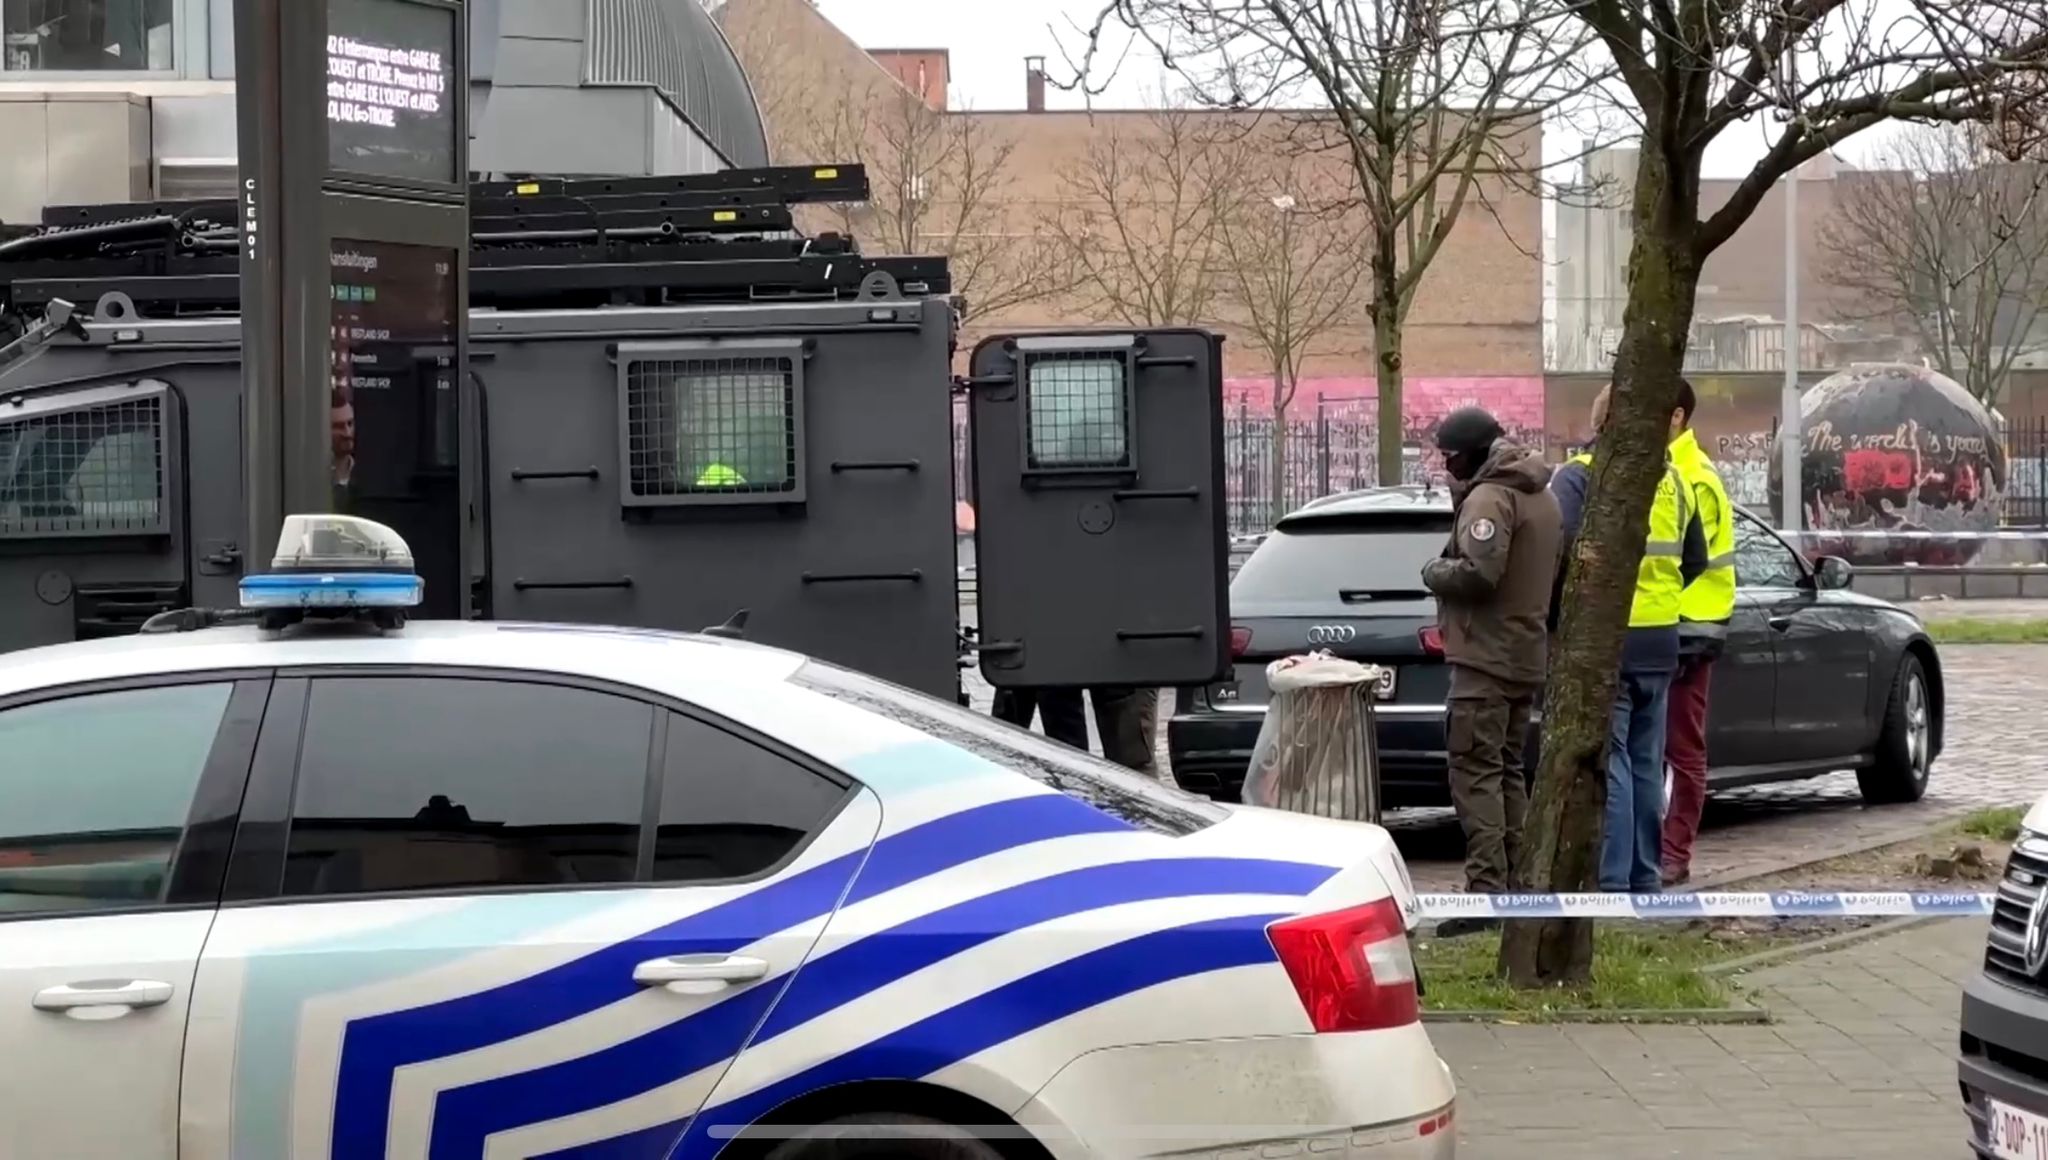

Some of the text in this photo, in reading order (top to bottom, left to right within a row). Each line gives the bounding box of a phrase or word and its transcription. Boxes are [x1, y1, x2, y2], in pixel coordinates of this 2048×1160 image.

[327, 57, 357, 78] 'OUEST
[357, 64, 366, 80] et
[390, 49, 409, 66] entre
[410, 49, 430, 70] GARE
[430, 53, 441, 71] DE
[345, 81, 367, 101] GARE
[367, 85, 379, 104] DE
[1808, 420, 1842, 450] The
